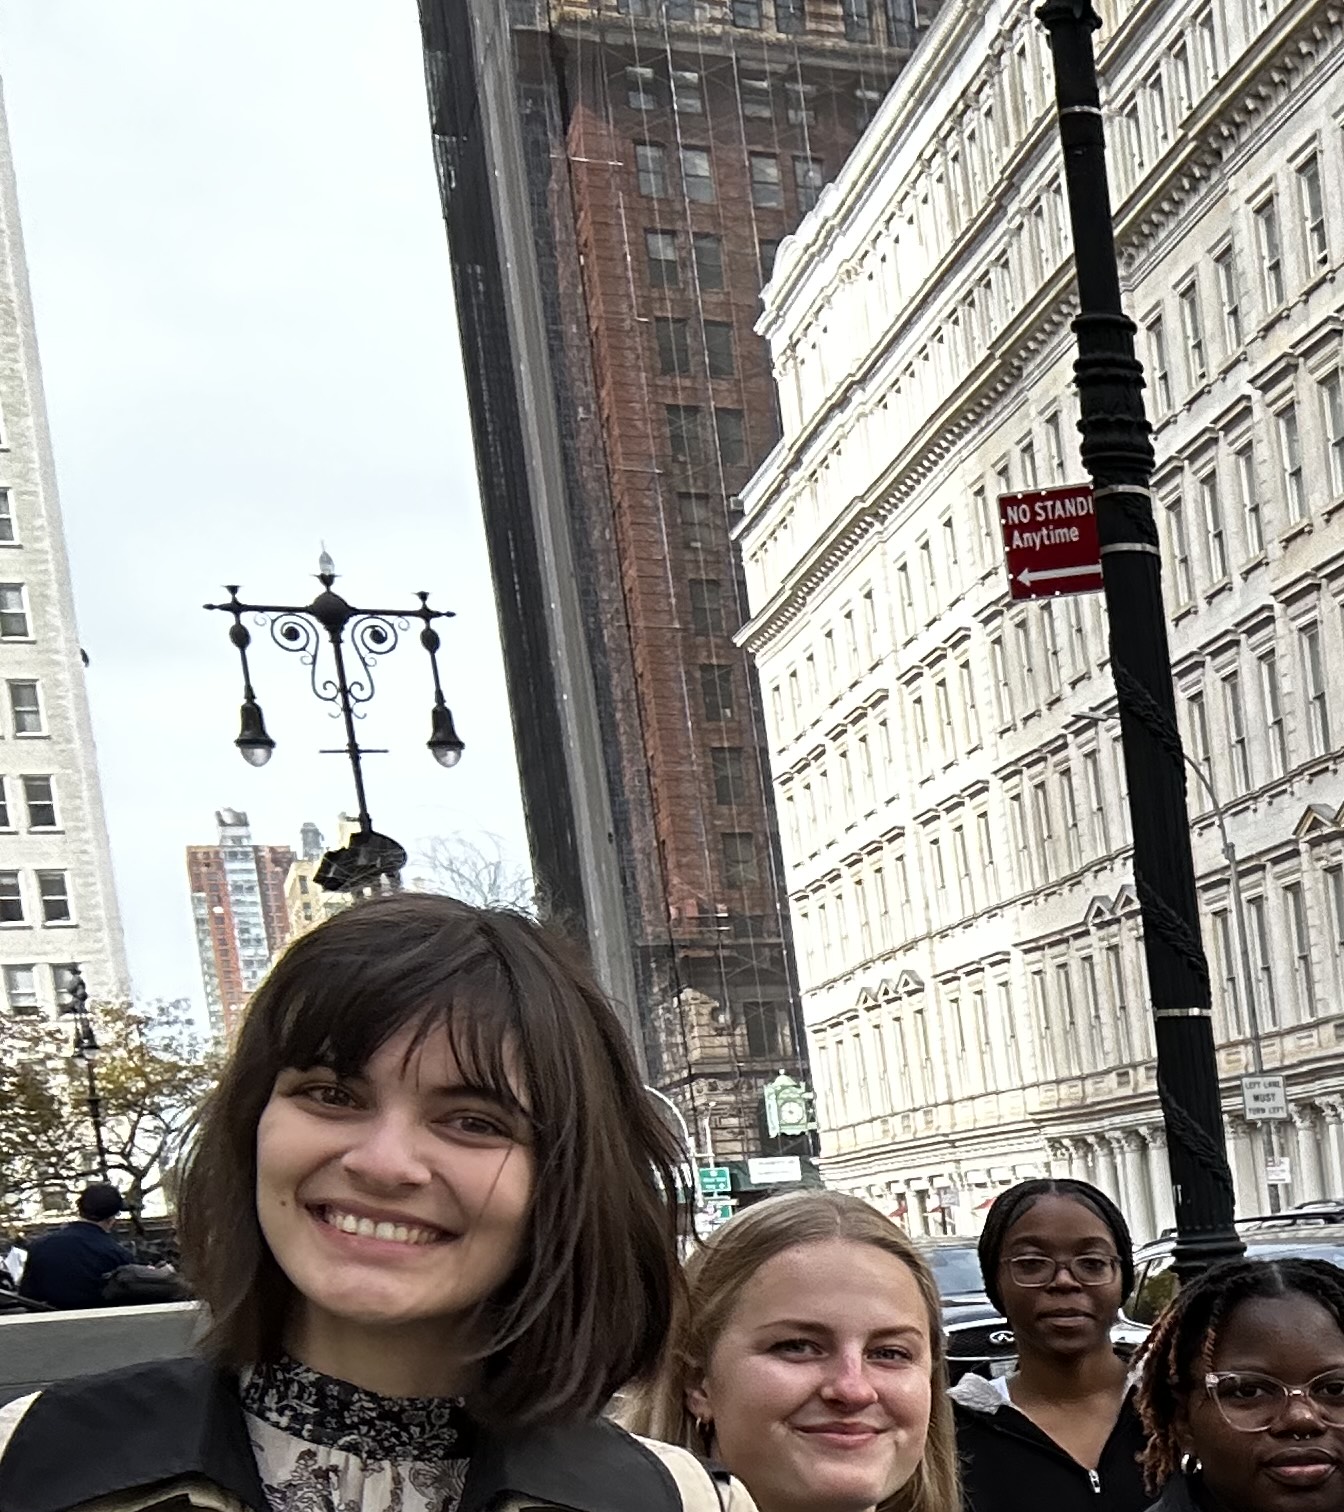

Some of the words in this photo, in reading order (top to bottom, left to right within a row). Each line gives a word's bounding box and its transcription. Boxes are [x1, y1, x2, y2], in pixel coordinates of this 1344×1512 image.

[1006, 503, 1031, 526] NO
[1034, 495, 1094, 522] STANDI
[1012, 524, 1080, 551] Anytime
